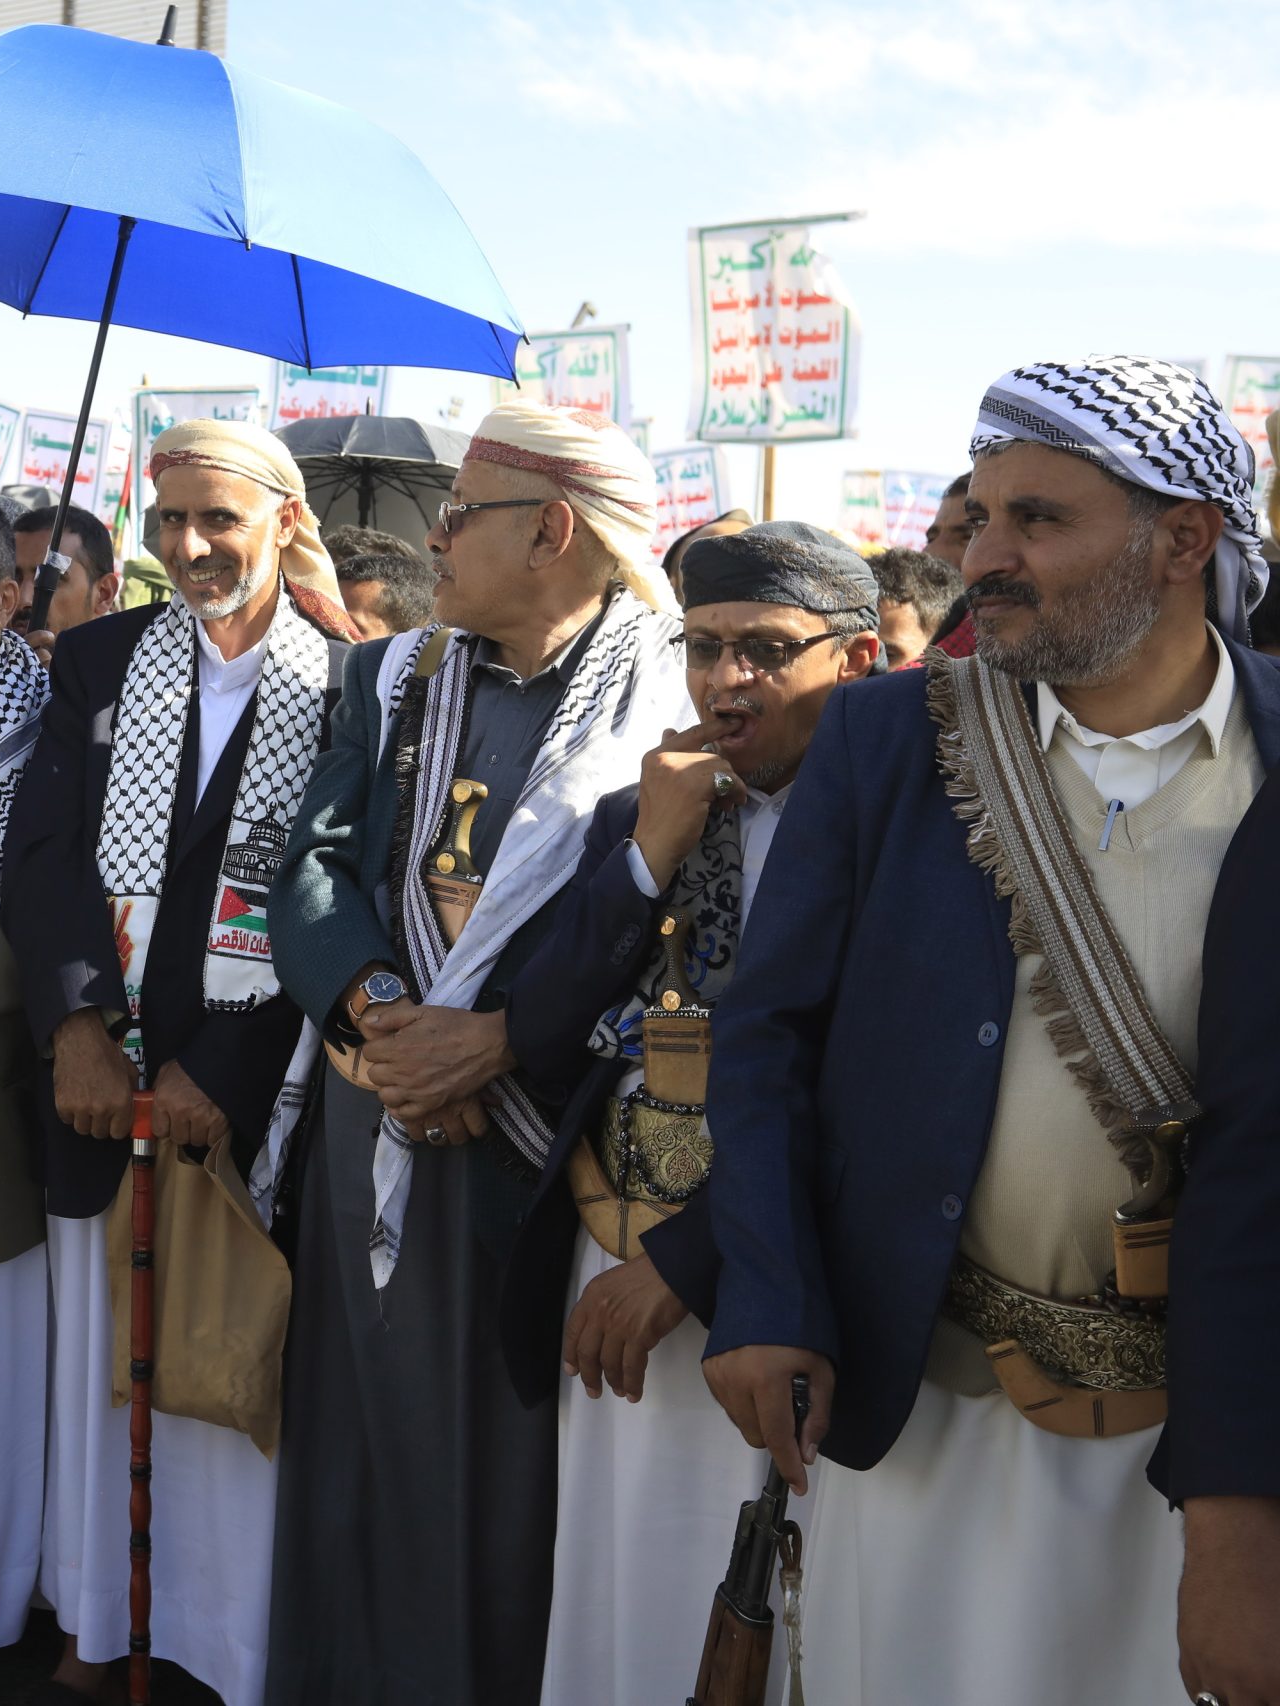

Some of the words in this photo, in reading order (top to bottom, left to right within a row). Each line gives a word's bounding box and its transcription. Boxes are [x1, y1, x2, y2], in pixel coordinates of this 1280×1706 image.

[710, 229, 784, 283] أكبر
[779, 320, 840, 349] الموت
[567, 345, 609, 376] الله
[761, 361, 783, 388] على
[792, 357, 839, 381] اللعنة
[712, 362, 756, 391] اليهود
[775, 390, 836, 430] النصر
